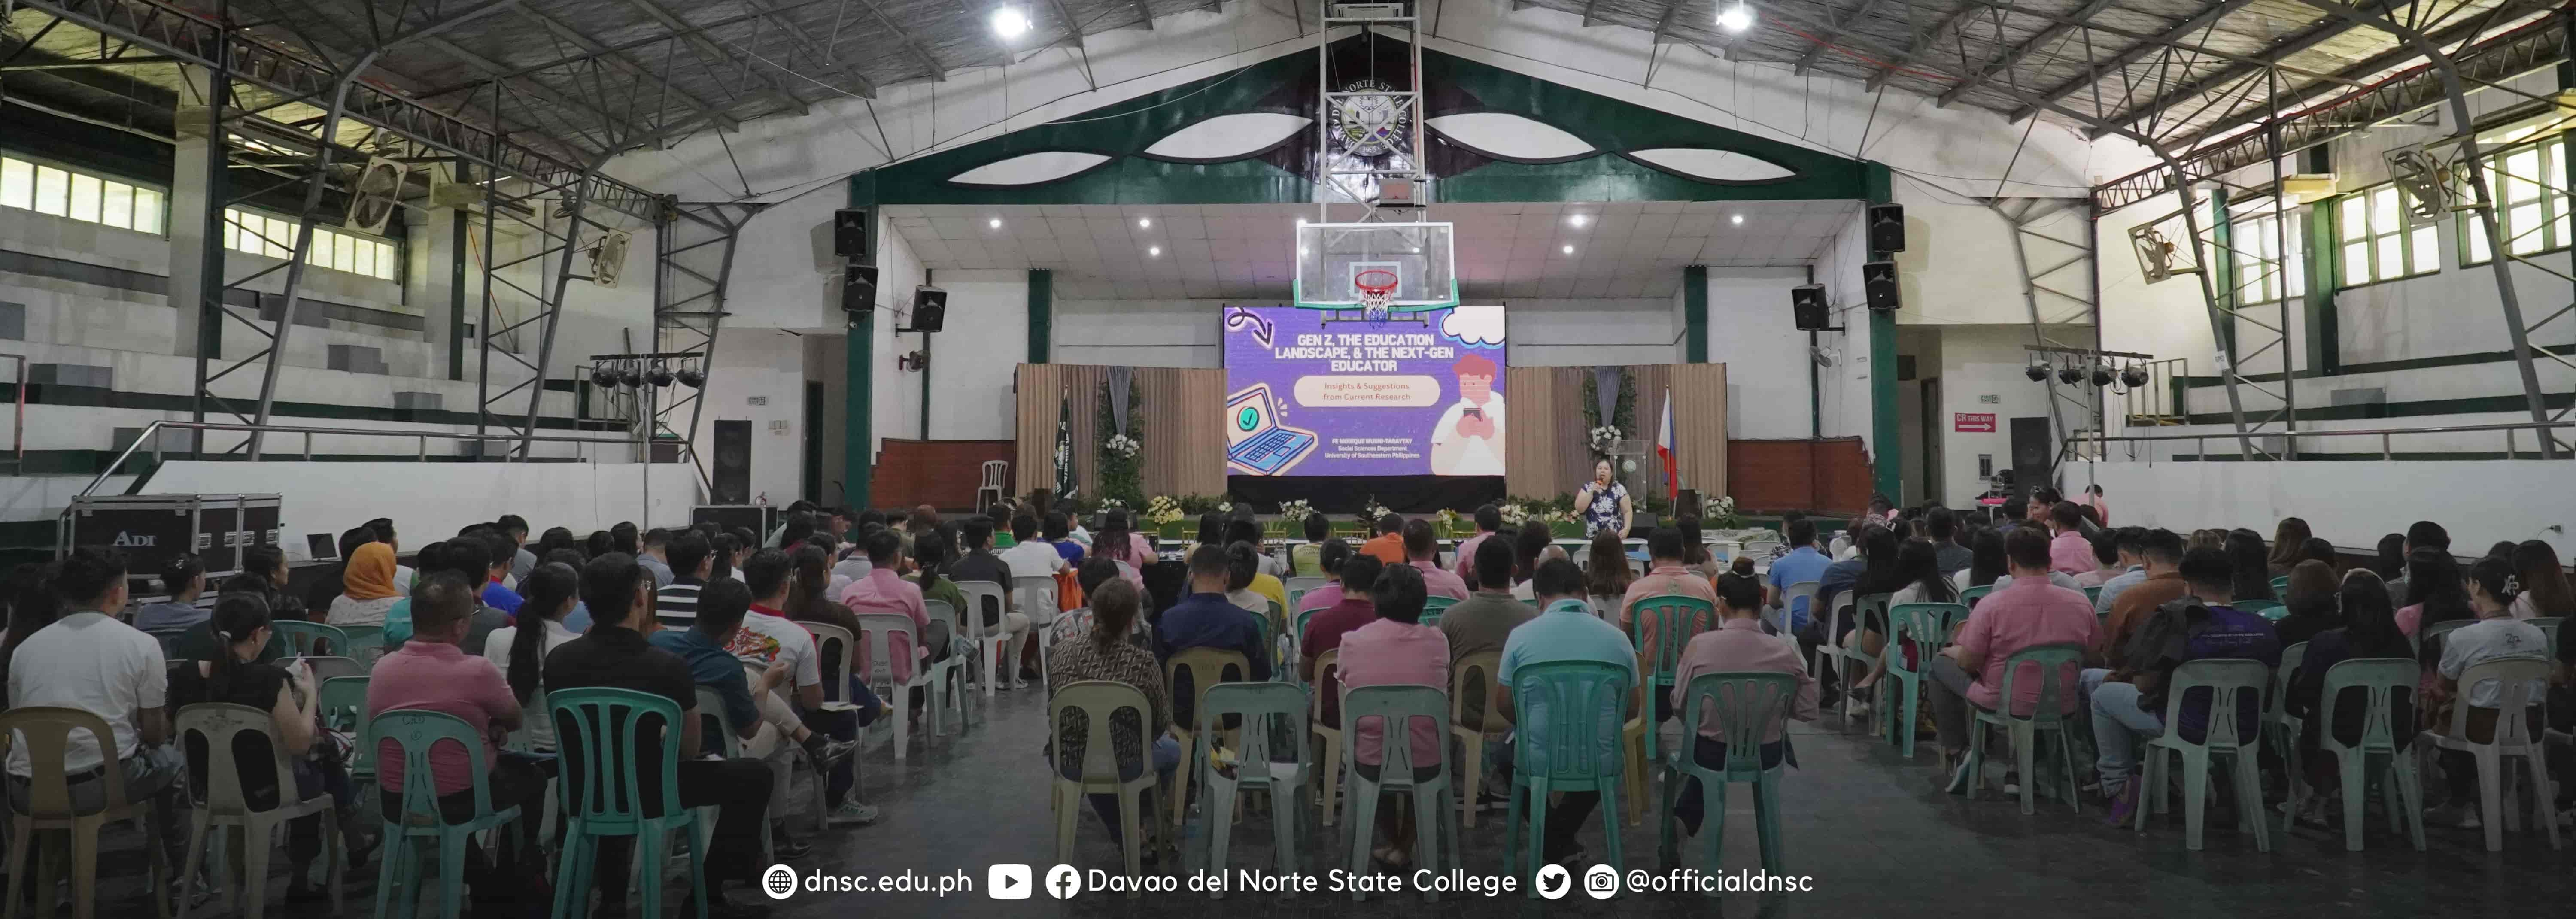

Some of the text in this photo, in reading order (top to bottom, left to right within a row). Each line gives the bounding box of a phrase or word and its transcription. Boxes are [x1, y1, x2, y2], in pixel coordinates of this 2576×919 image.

[1298, 334, 1434, 347] GEN Z, THE EDUCATION
[1275, 347, 1454, 359] LANDSCAPE, & THE NEXT-GEN
[1331, 360, 1397, 371] EDUCATOR
[1324, 382, 1355, 391] Insights
[1363, 382, 1410, 391] Suggestions
[113, 530, 157, 547] ADI
